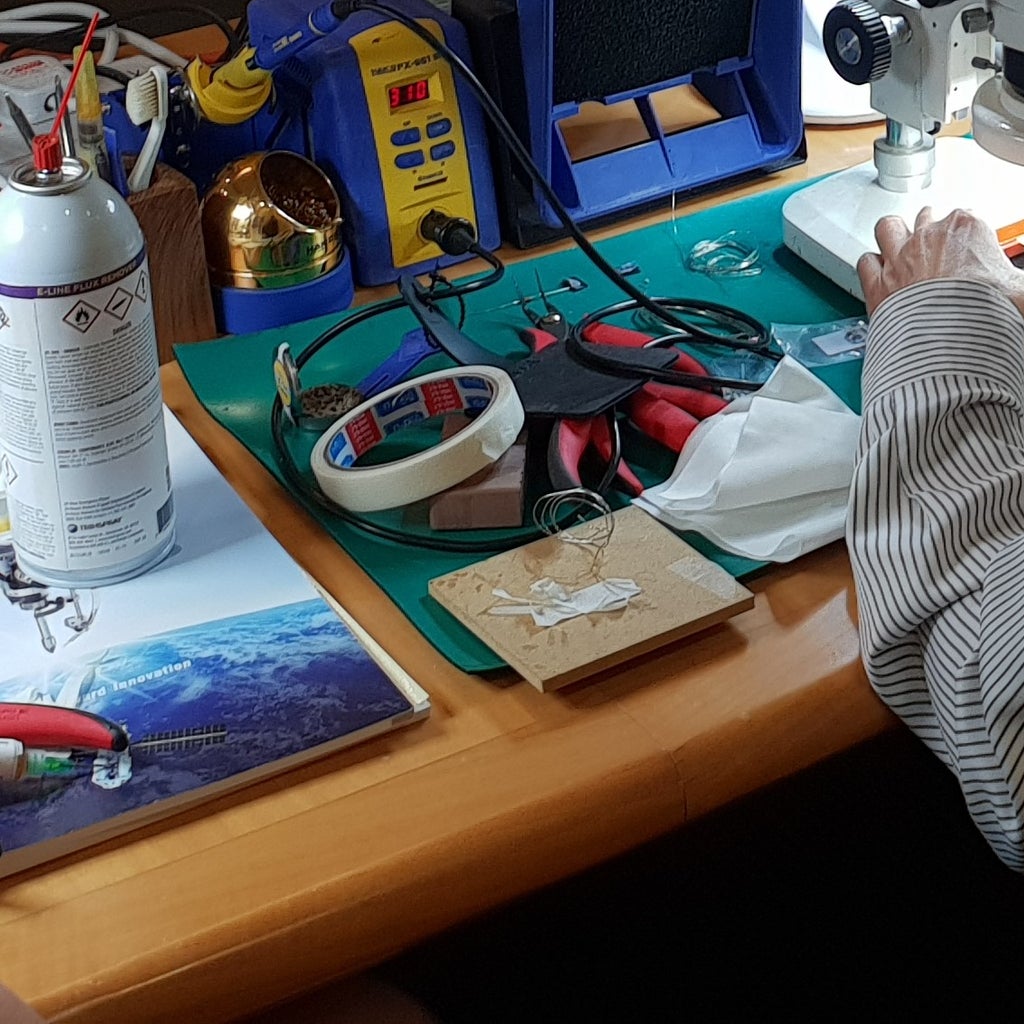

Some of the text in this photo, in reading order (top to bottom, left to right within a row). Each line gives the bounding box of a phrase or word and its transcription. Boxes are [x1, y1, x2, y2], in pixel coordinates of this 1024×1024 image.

[390, 81, 427, 108] 310
[37, 286, 71, 297] E-LINE
[73, 279, 99, 291] FLUX
